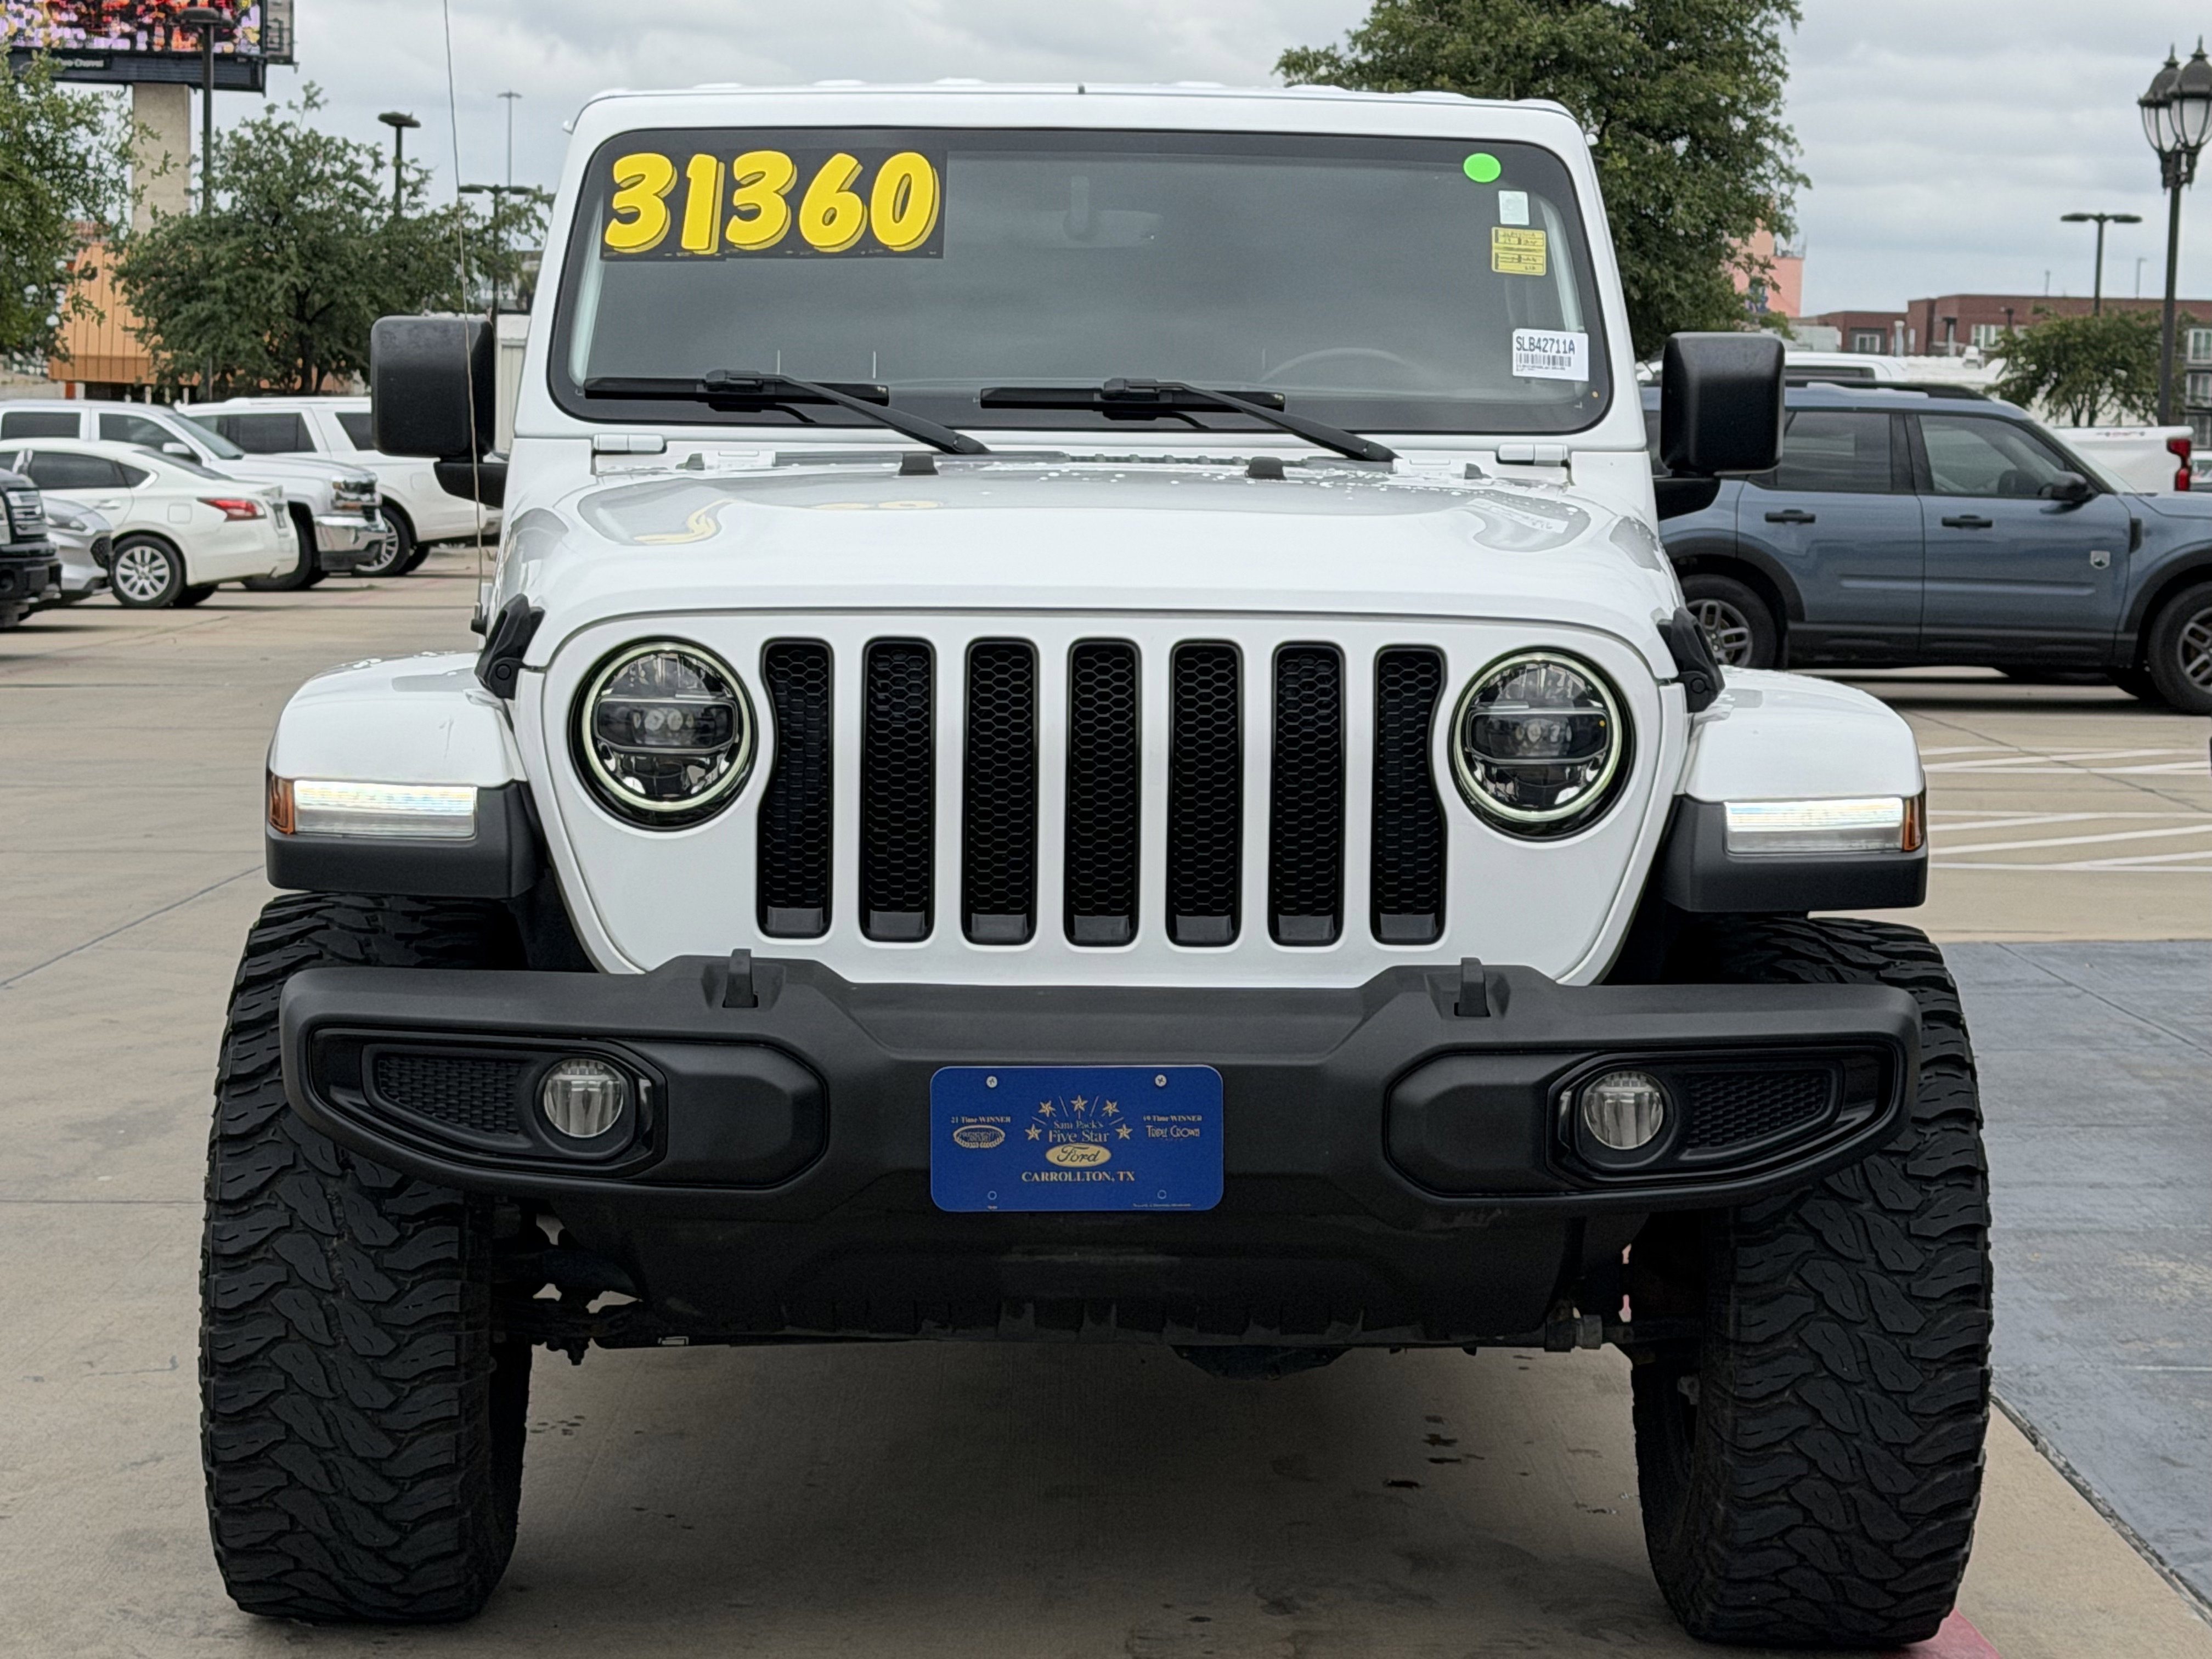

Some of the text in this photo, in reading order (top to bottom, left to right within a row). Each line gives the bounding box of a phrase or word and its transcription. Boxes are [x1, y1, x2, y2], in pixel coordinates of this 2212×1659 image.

[605, 150, 940, 255] 31360
[1516, 335, 1575, 354] SLB42711A
[1048, 1130, 1110, 1143] Five Star
[1057, 1145, 1101, 1163] Ford
[1022, 1171, 1135, 1182] CARROLLTON, TX
